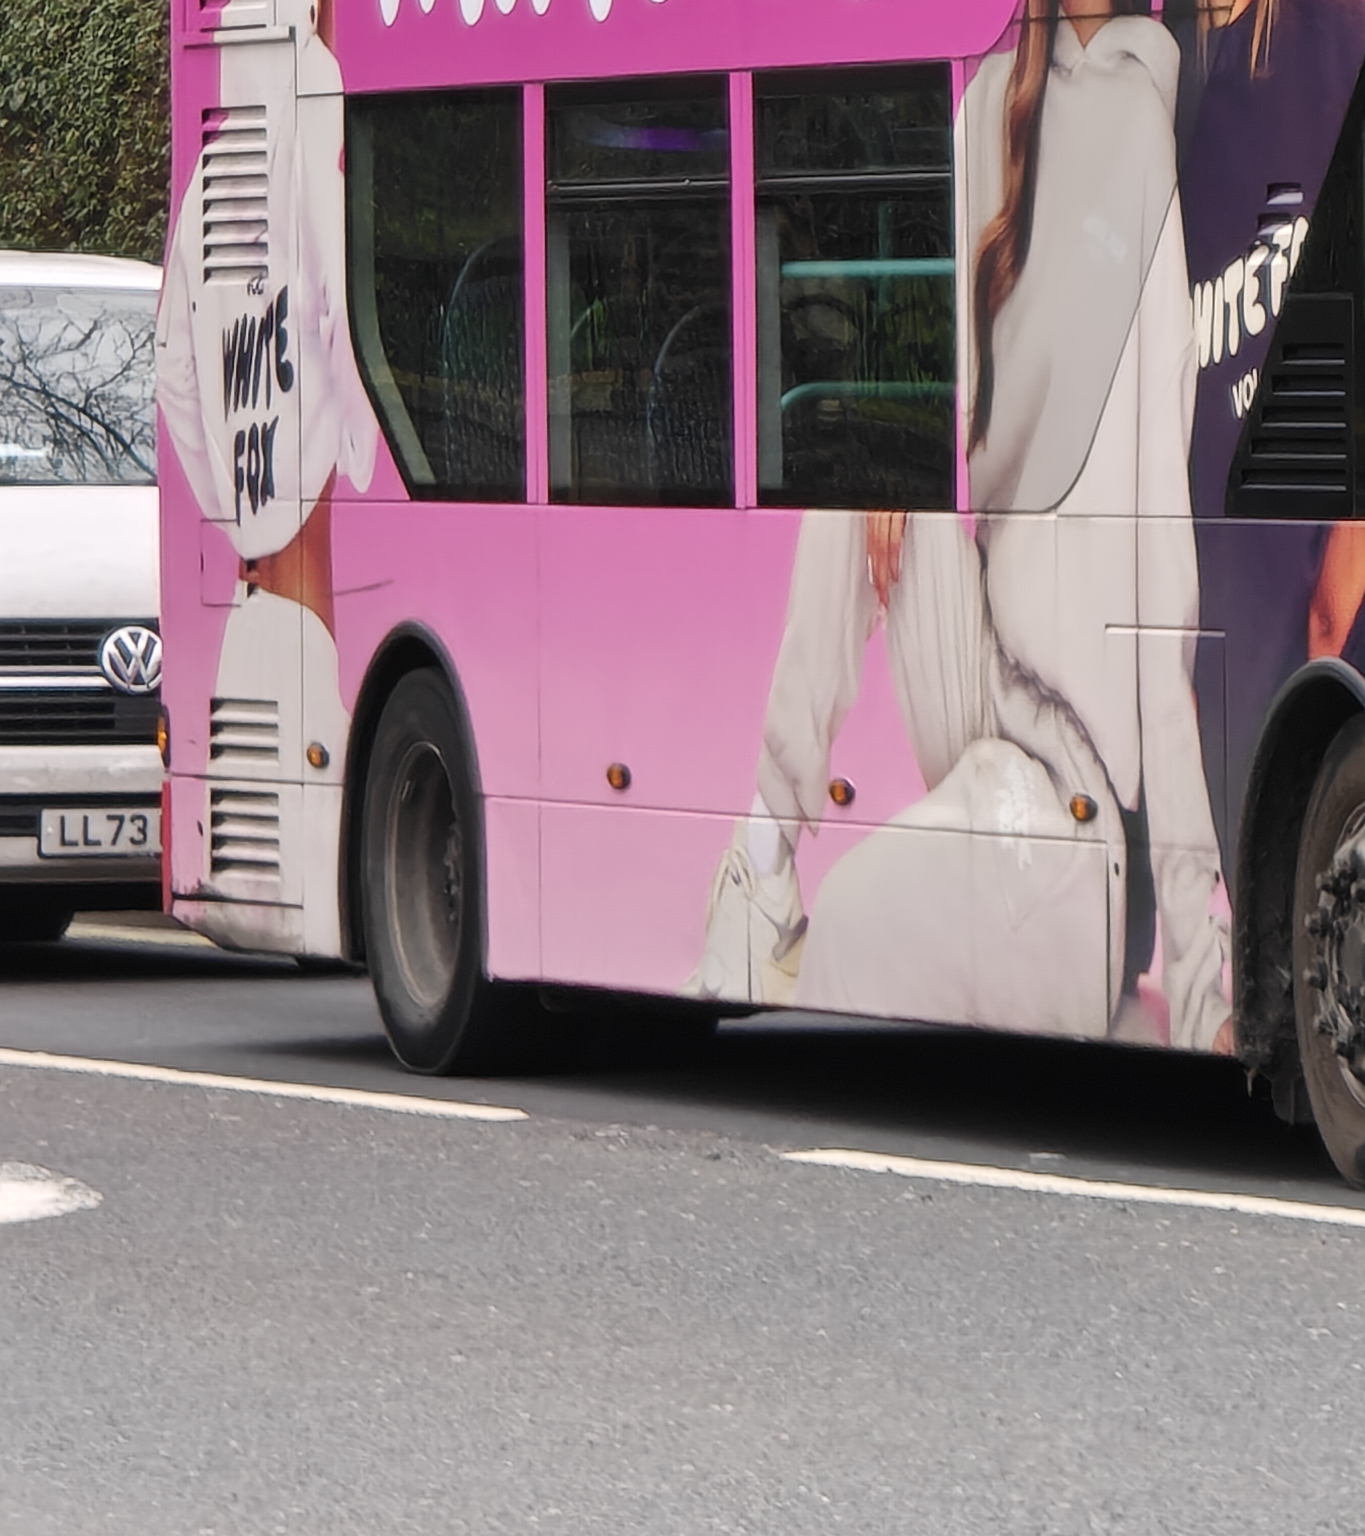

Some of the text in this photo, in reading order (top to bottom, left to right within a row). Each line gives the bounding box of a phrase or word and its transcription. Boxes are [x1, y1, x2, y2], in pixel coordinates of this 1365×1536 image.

[222, 284, 295, 424] WHITE
[1192, 238, 1270, 370] HITE
[233, 414, 280, 529] FOX
[59, 814, 149, 848] LL73
